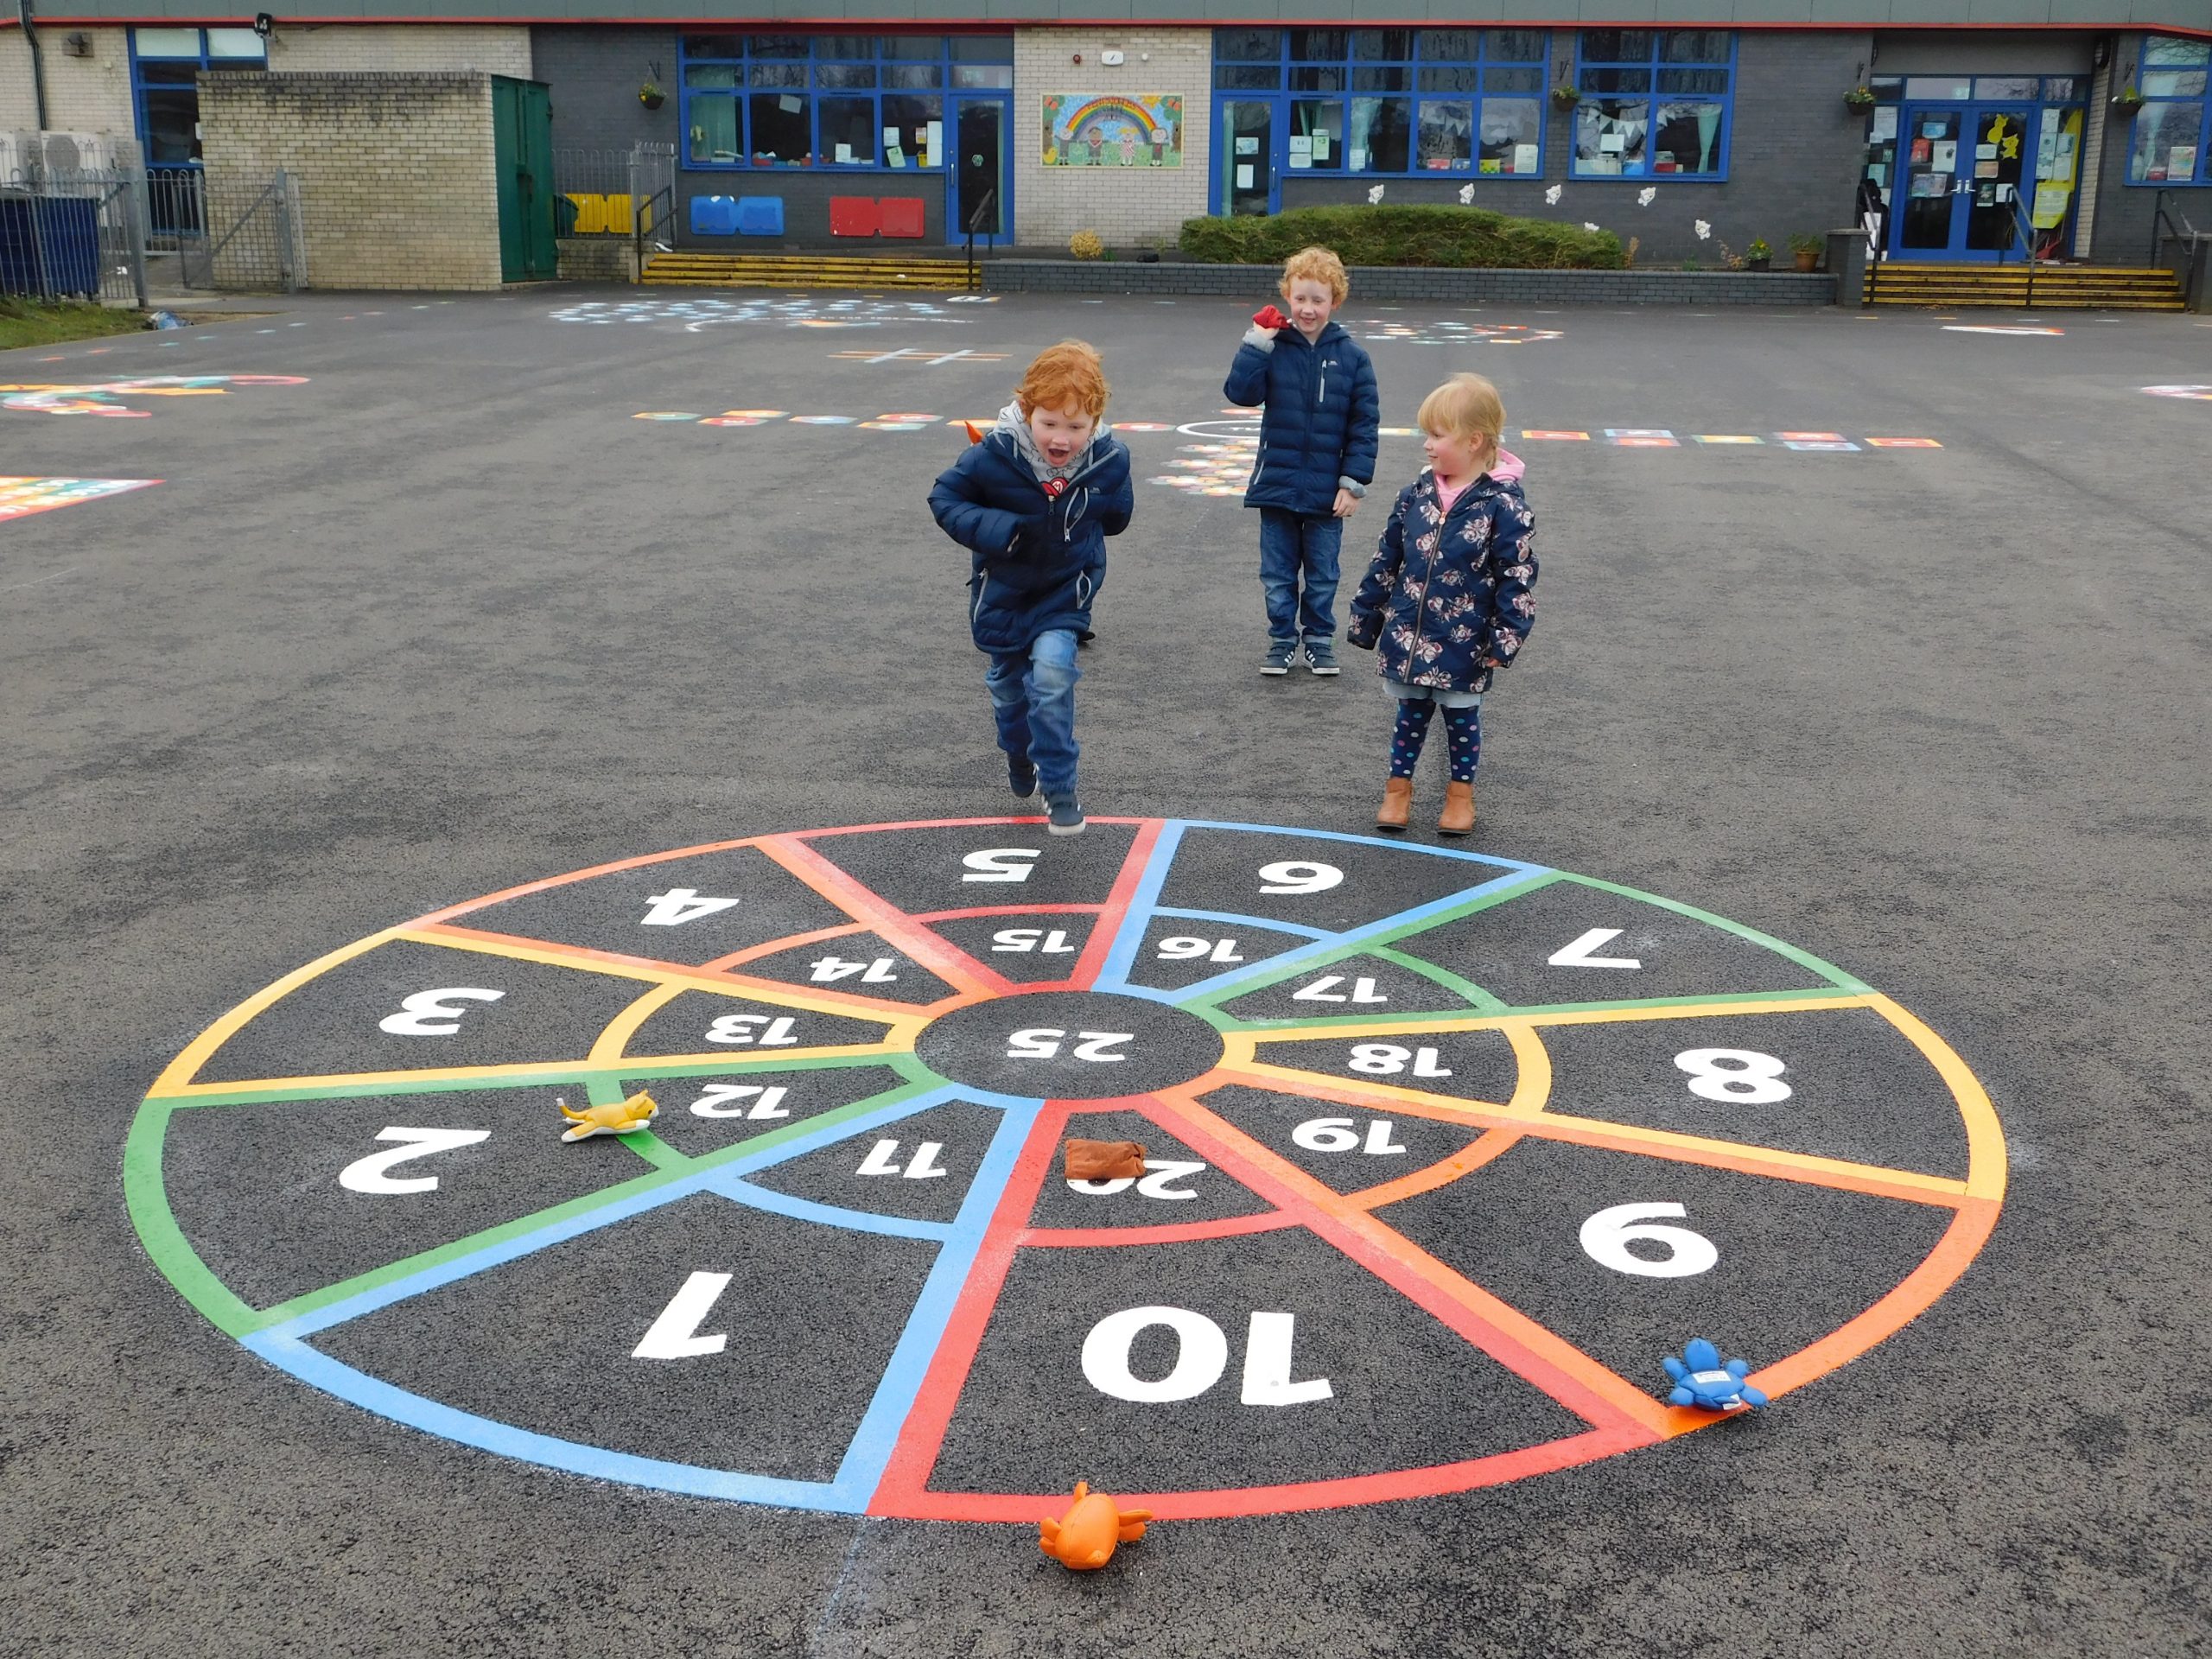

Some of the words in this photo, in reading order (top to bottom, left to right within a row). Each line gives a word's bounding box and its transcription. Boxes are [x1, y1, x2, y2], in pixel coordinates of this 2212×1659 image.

[962, 848, 1042, 882] 5
[1258, 861, 1344, 894] 6
[640, 887, 740, 926] 4
[991, 928, 1075, 953] 15
[1156, 936, 1243, 963] 16
[1548, 927, 1642, 969] 7
[810, 957, 898, 983] 14
[1292, 975, 1389, 1003] 17
[378, 987, 506, 1036] 3
[704, 1014, 798, 1046] 13
[1007, 1028, 1135, 1063] 25
[1348, 1043, 1452, 1077] 18
[1673, 1047, 1792, 1104] 8
[690, 1084, 790, 1120] 12
[1291, 1117, 1407, 1155] 19
[339, 1126, 492, 1195] 2
[855, 1139, 947, 1179] 11
[1579, 1201, 1719, 1278] 9
[631, 1270, 734, 1360] 1
[1080, 1306, 1334, 1407] 10
